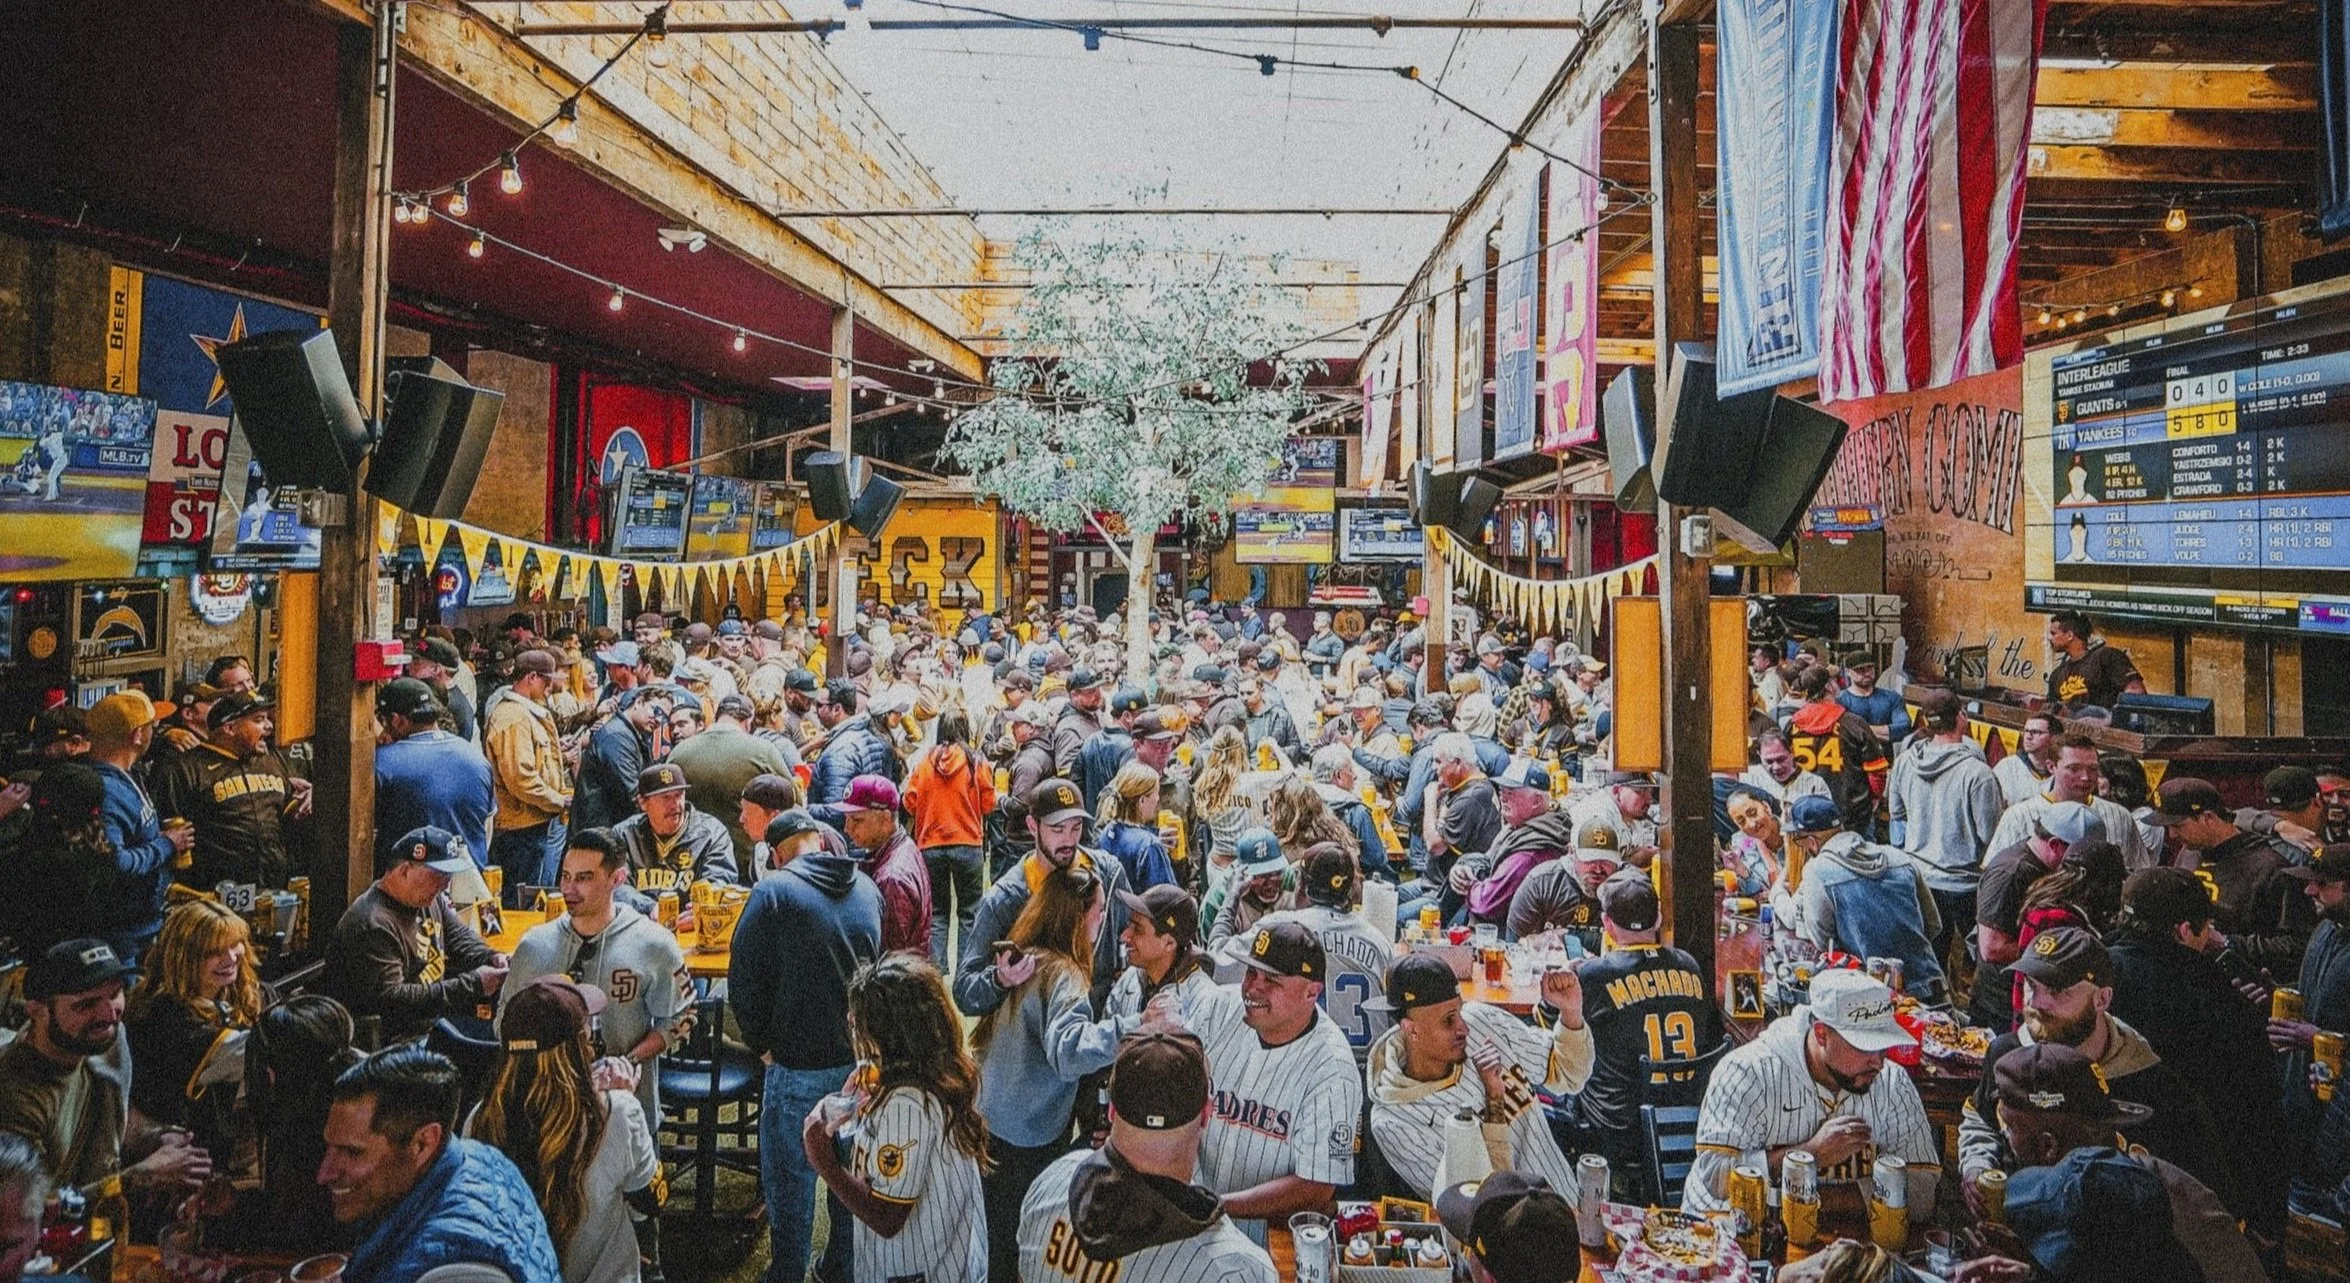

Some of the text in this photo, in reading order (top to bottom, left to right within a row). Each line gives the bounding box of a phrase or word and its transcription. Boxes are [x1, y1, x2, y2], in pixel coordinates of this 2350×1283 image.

[1756, 0, 1797, 353] OONSHINE
[2287, 343, 2309, 357] 2:33
[2057, 359, 2131, 386] INTERLEAGUE
[2166, 366, 2189, 378] FINAL
[2083, 380, 2114, 393] STADIUM
[2172, 379, 2228, 401] 0 4 0
[2076, 398, 2114, 416] GIANTS
[2173, 410, 2228, 432] 5 8 0
[2077, 425, 2124, 443] YANKEES
[172, 423, 228, 470] LO
[2172, 444, 2217, 458] CONFORTO
[2267, 438, 2274, 449] 2
[2276, 437, 2284, 448] K
[2105, 452, 2131, 463] WEBB
[2173, 451, 2285, 470] YASTRZEMSKI 0-2 2 K
[2173, 466, 2275, 483] ESTRADA 2-4 K
[2173, 479, 2286, 496] CRAWFORD 0-3 2 K
[170, 498, 216, 540] ST
[2290, 507, 2298, 517] 3
[2300, 506, 2308, 516] K
[2269, 523, 2284, 533] HR
[2304, 523, 2311, 533] 2
[2269, 537, 2284, 547] HR
[2304, 537, 2311, 547] 2
[2174, 551, 2201, 560] VOLPE
[2045, 589, 2056, 597] TOP
[2130, 602, 2138, 611] AS
[2138, 603, 2157, 612] YANKS
[2158, 604, 2172, 613] KICK
[2173, 605, 2185, 614] OFF
[2186, 606, 2213, 615] SEASON
[1997, 637, 2036, 680] the
[1792, 736, 1844, 772] 54
[213, 773, 286, 803] SAN DIEGO
[636, 867, 694, 892] ADRS
[226, 888, 251, 908] 63
[1322, 931, 1376, 970] CHADO
[611, 968, 638, 1004] SD
[1605, 969, 1703, 1010] MACHADO
[1643, 1011, 1697, 1084] 13
[1209, 1077, 1292, 1138] ADRES
